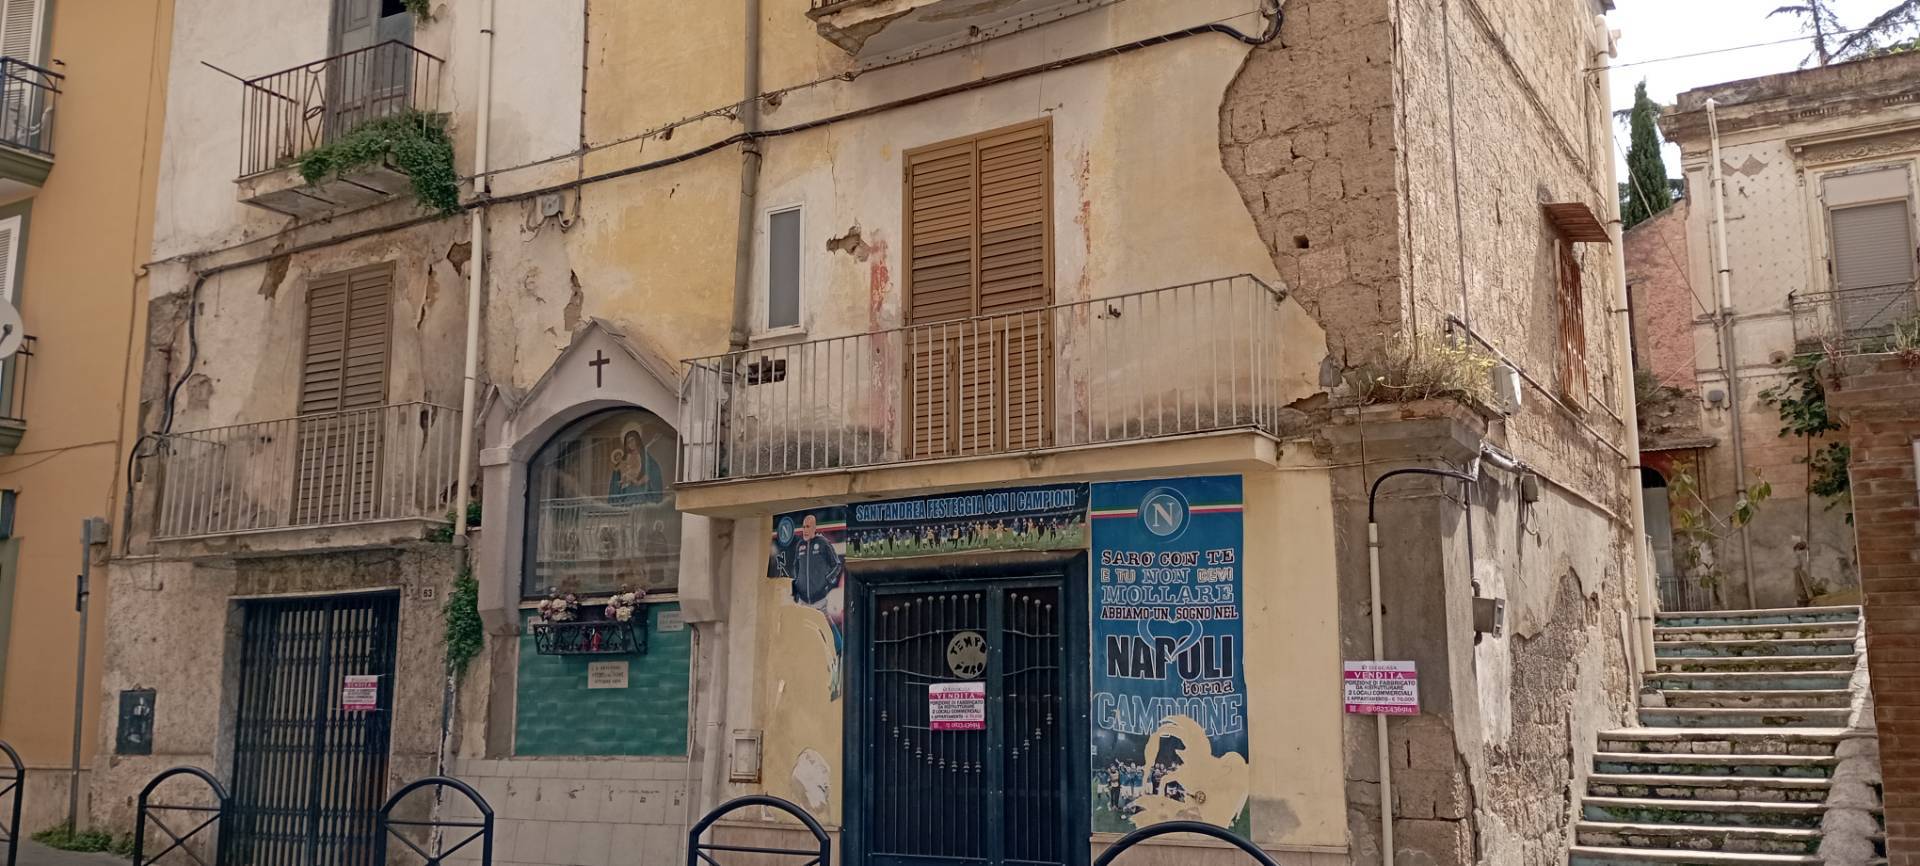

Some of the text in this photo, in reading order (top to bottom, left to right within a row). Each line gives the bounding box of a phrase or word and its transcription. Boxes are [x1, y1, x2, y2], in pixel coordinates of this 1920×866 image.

[856, 489, 1075, 521] SANT'ANDREA FESTEGGIA CON I CAMPIONI
[1152, 502, 1175, 527] N
[1160, 551, 1200, 567] CON
[1206, 548, 1236, 566] TE
[1101, 568, 1111, 583] E
[1115, 568, 1136, 584] TU
[1143, 568, 1190, 585] NON
[1101, 583, 1234, 606] MOLLARE
[1100, 604, 1239, 621] ABBIAMO UN SOGNO NEL
[1106, 634, 1234, 681] NAPOLI
[1182, 680, 1234, 696] torna
